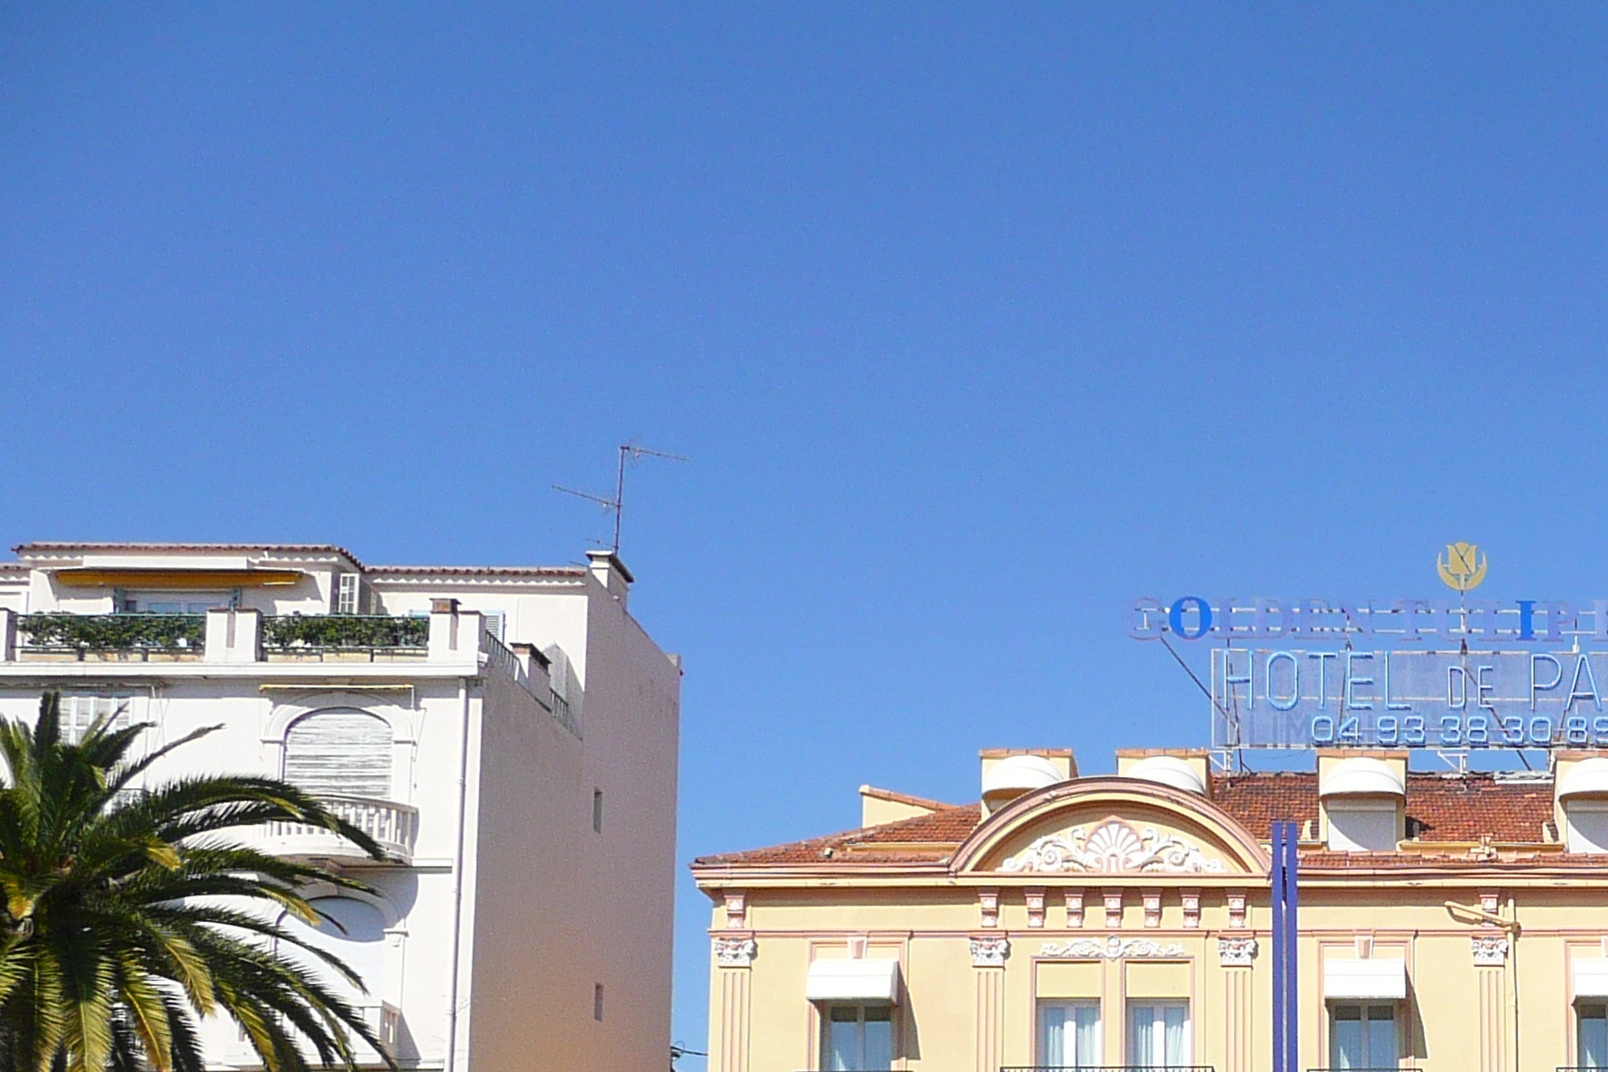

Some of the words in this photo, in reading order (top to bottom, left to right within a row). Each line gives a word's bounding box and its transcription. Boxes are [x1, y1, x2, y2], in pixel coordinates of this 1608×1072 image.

[1126, 596, 1375, 641] GOLDEN
[1393, 598, 1577, 641] TULIP
[1223, 650, 1412, 711] HOTEL
[1447, 665, 1493, 710] DE
[1311, 715, 1362, 746] 04
[1376, 715, 1426, 746] 93
[1440, 715, 1488, 746] 38
[1502, 715, 1552, 746] 30
